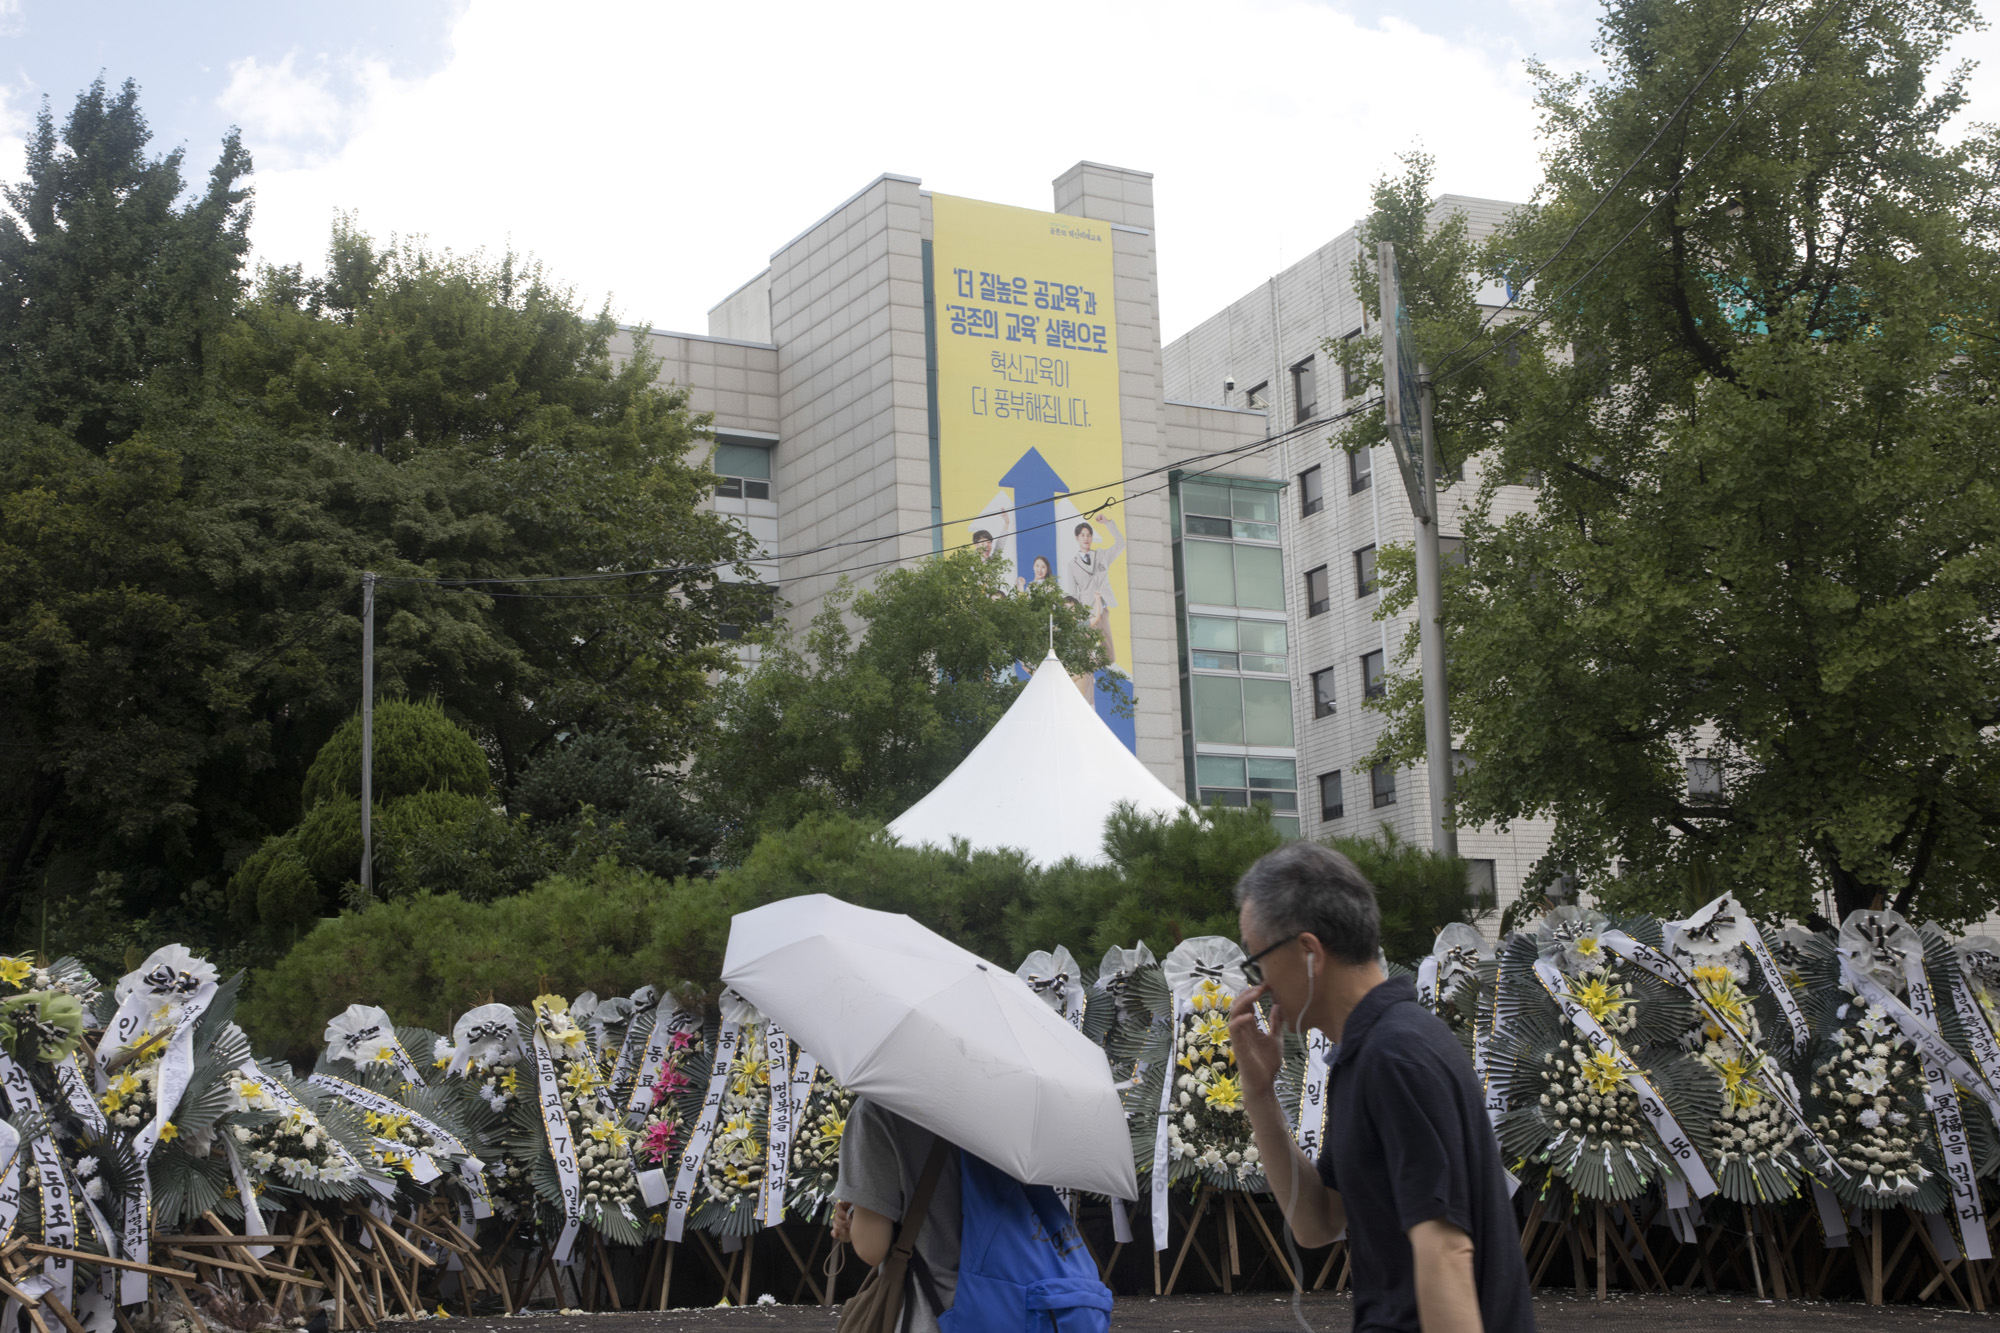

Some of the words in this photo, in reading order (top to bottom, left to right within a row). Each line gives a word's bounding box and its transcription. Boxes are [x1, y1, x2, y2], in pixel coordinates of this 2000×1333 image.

[979, 271, 1028, 306] 질높은
[1045, 318, 1108, 354] 실현으로
[990, 350, 1069, 389] 혁신교육이
[972, 386, 988, 417] 더
[994, 388, 1092, 428] 풍부해집니다.
[1755, 941, 1787, 993] 선생님
[537, 1046, 555, 1082] 초등
[767, 1024, 785, 1071] 고인의
[545, 1093, 566, 1127] 교사
[770, 1081, 790, 1133] 명복을
[1911, 983, 1934, 1020] 삼가
[1949, 1162, 1985, 1225] 빕니다
[770, 1141, 787, 1192] 빕니다
[564, 1186, 579, 1229] 일동
